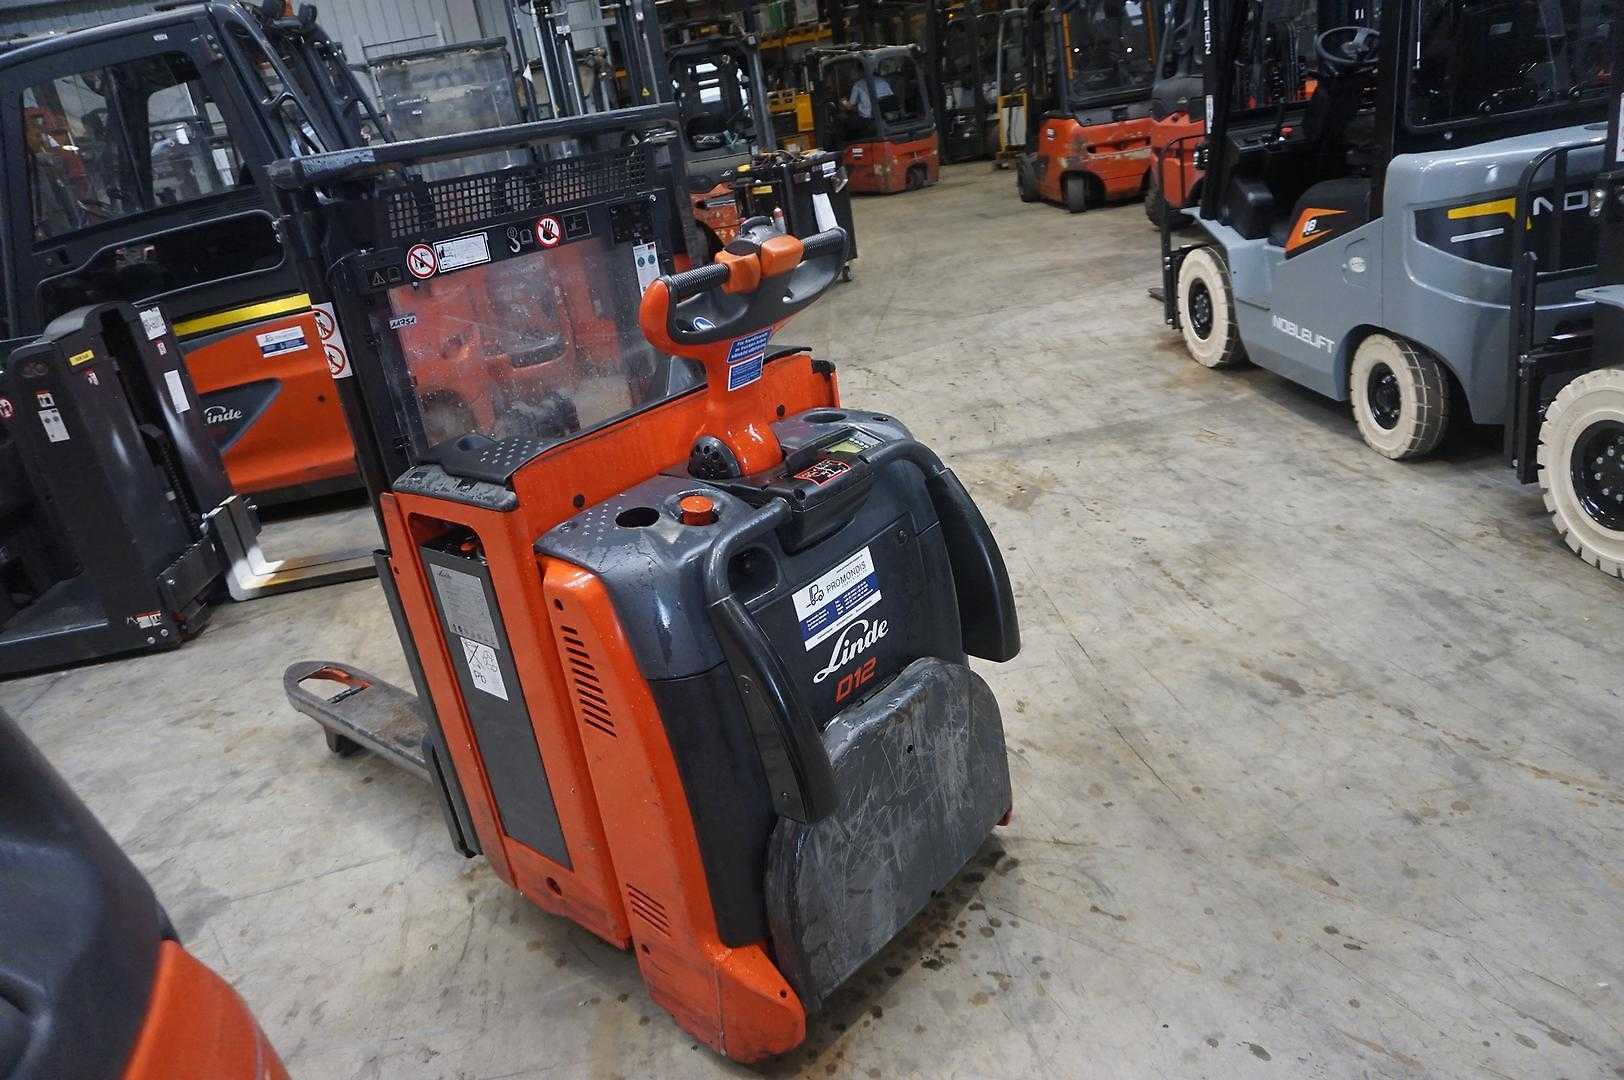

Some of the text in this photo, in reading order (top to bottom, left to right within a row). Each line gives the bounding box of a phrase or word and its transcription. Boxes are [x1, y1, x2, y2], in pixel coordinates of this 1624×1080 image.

[1273, 315, 1335, 354] NOBLELIFT
[825, 560, 867, 593] PROMONDIS
[813, 619, 889, 684] Linde
